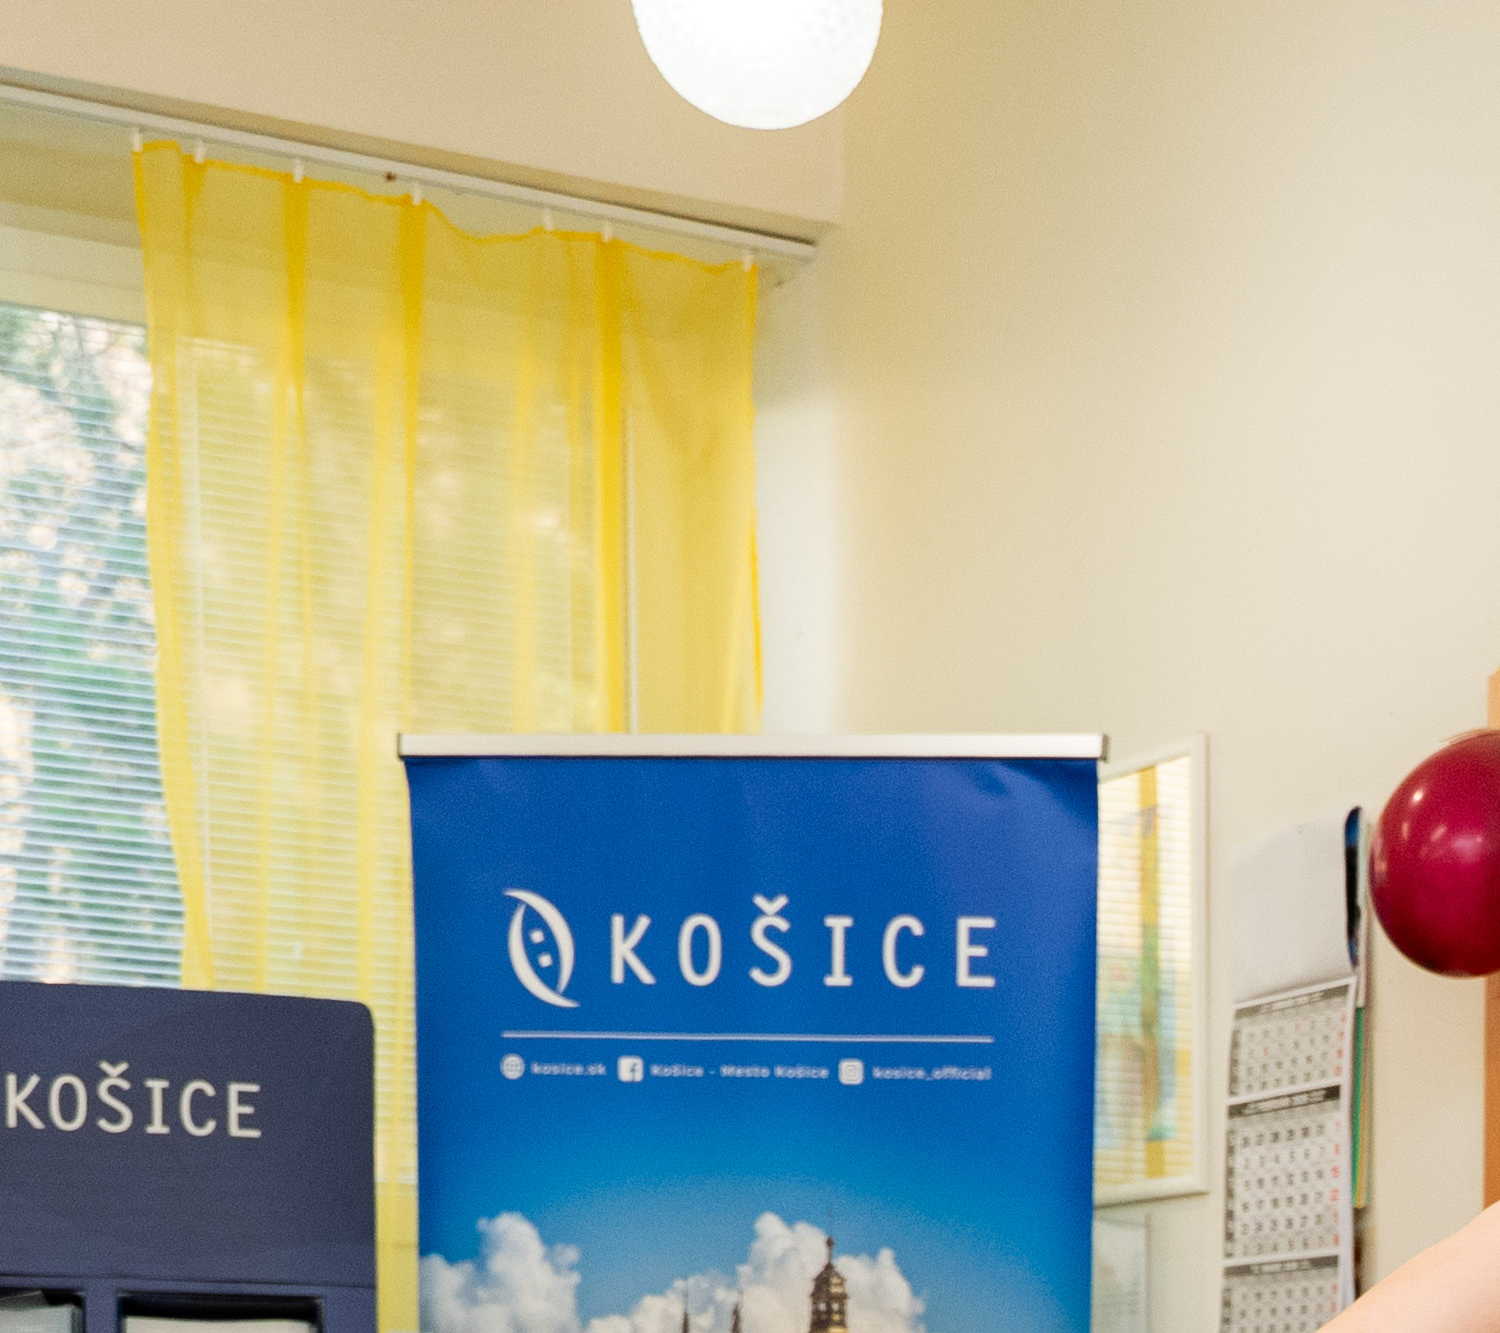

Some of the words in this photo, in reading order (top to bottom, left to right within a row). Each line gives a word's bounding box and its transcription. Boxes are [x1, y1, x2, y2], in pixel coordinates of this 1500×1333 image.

[610, 893, 997, 989] KOŠICE
[6, 1061, 263, 1139] KOŠICE
[530, 1062, 607, 1076] kosice.sk
